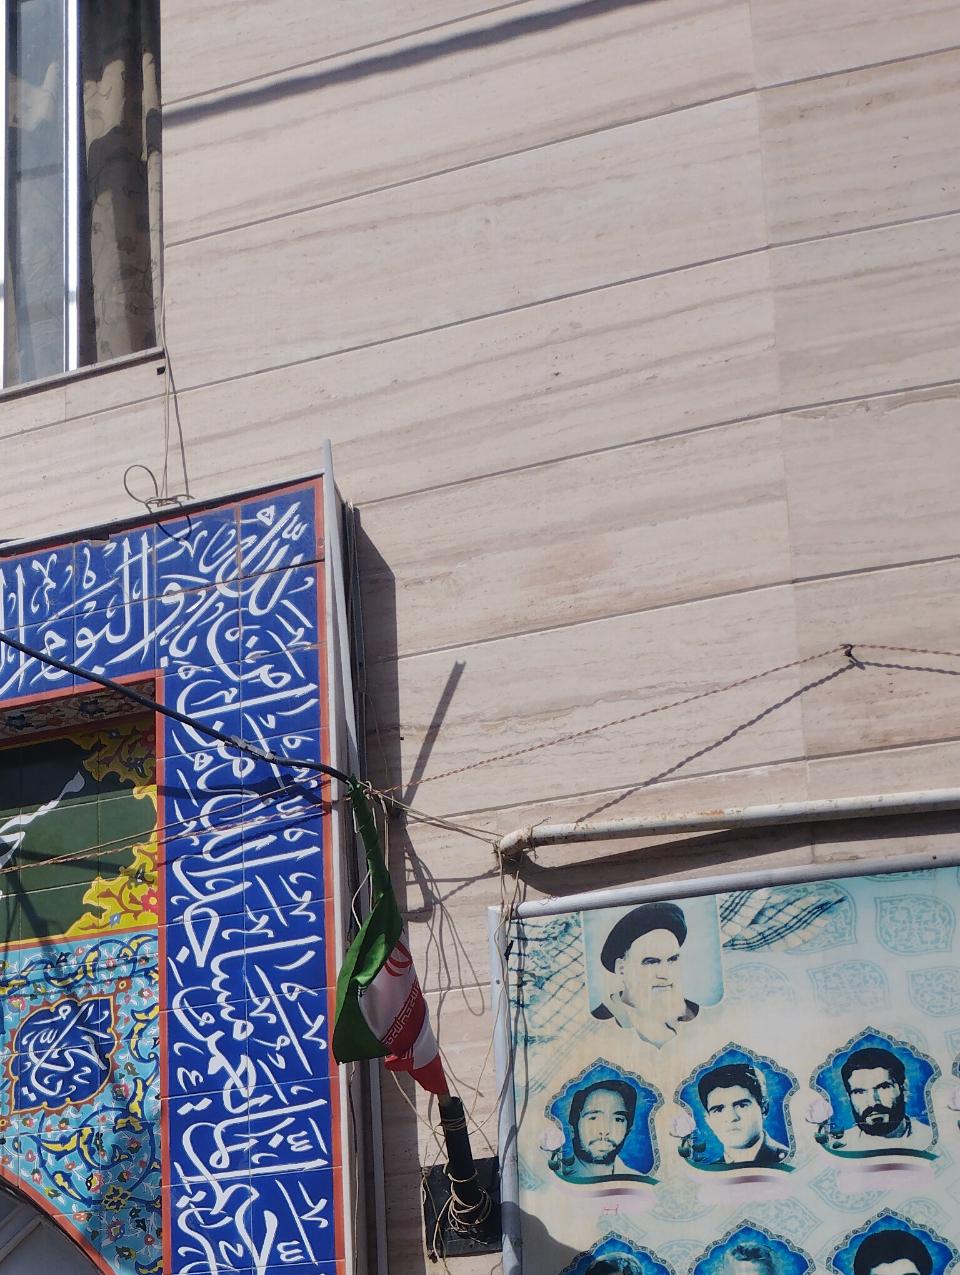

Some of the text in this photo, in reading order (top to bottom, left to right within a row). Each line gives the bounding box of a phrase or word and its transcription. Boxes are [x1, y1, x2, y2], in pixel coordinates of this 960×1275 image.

[30, 535, 185, 683] واليوم
[187, 762, 320, 876] الله
[172, 856, 322, 1041] مساجد
[174, 986, 272, 1114] يعمر
